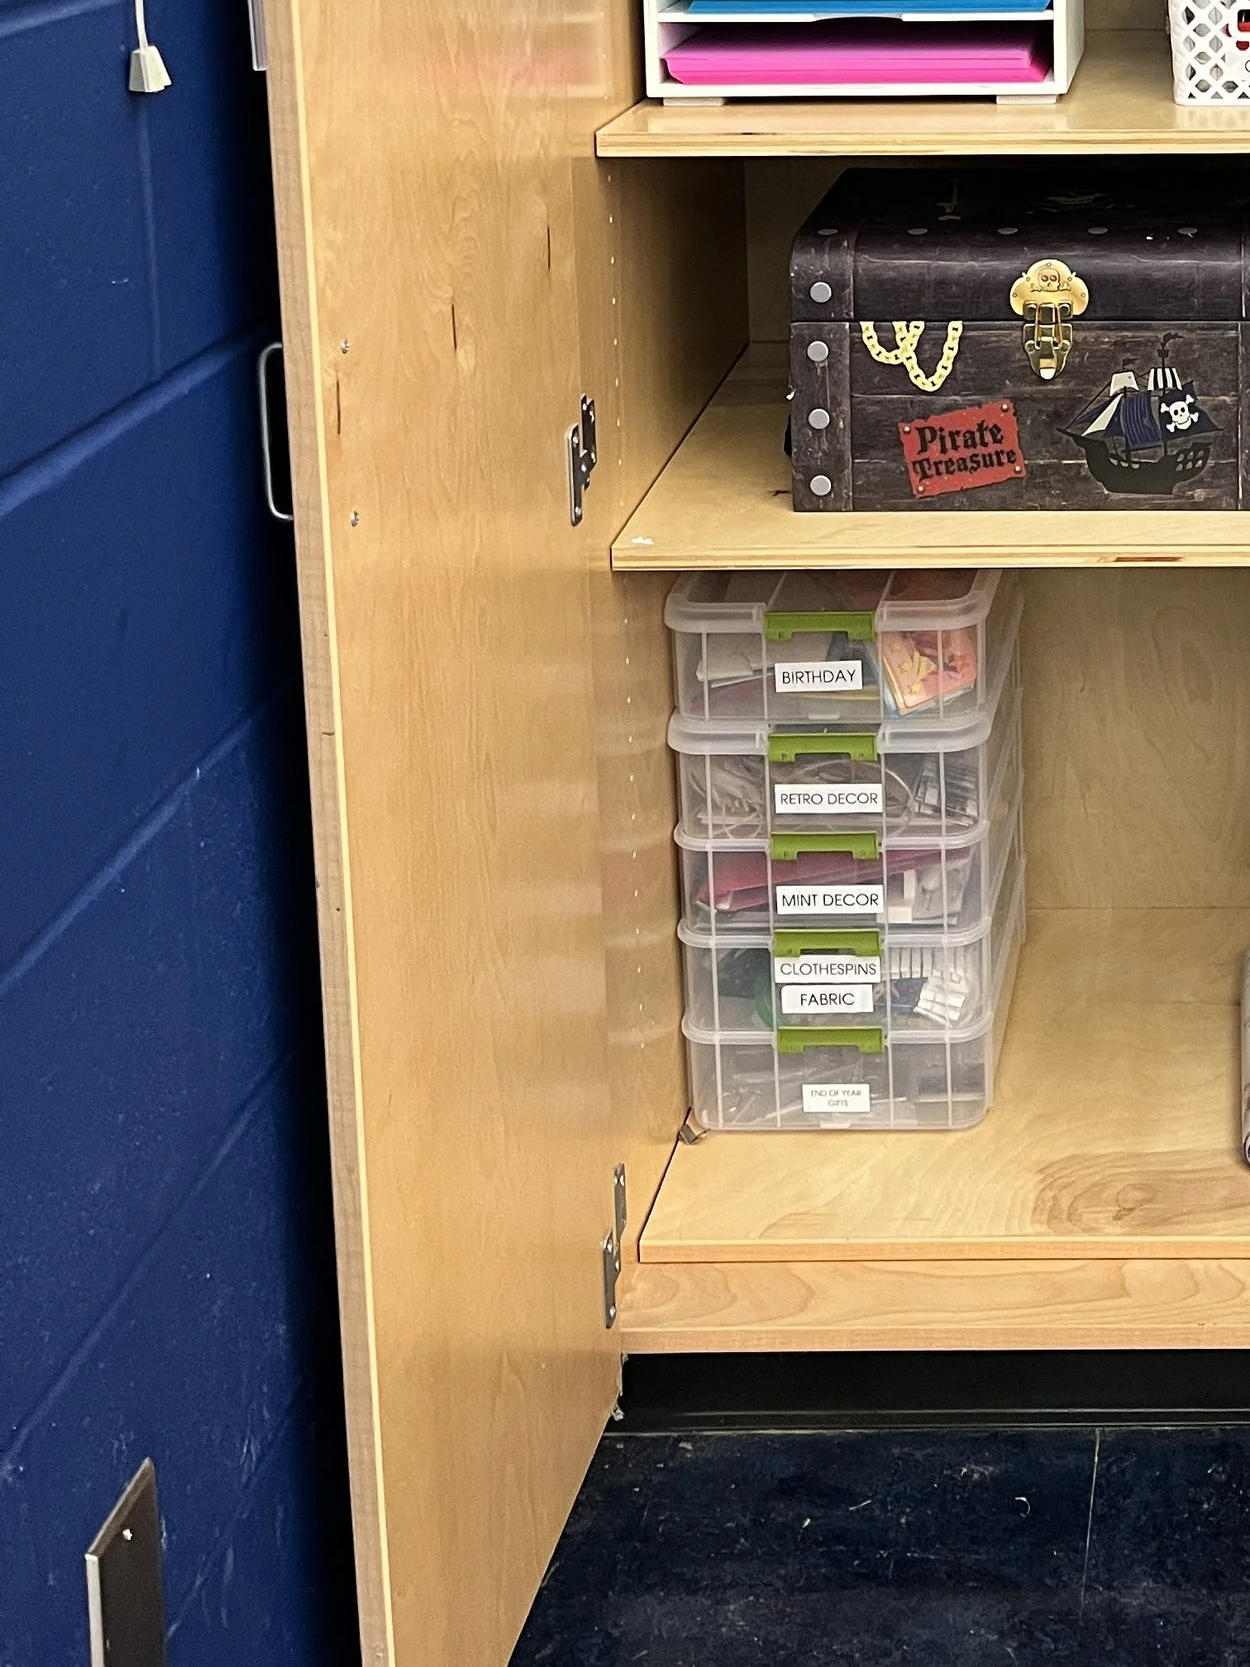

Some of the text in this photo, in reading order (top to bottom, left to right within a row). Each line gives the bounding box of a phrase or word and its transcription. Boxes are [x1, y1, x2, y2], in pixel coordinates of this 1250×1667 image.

[915, 419, 1004, 454] Pirate
[912, 449, 1017, 482] Treasure
[781, 669, 857, 685] BIRTHDAY
[780, 791, 879, 806] RETRO DECOR
[782, 893, 879, 907] MINT DECOR
[780, 962, 877, 975] CLOTHESPINS
[800, 992, 855, 1006] FABRIC
[810, 1089, 862, 1097] END OF YEAR
